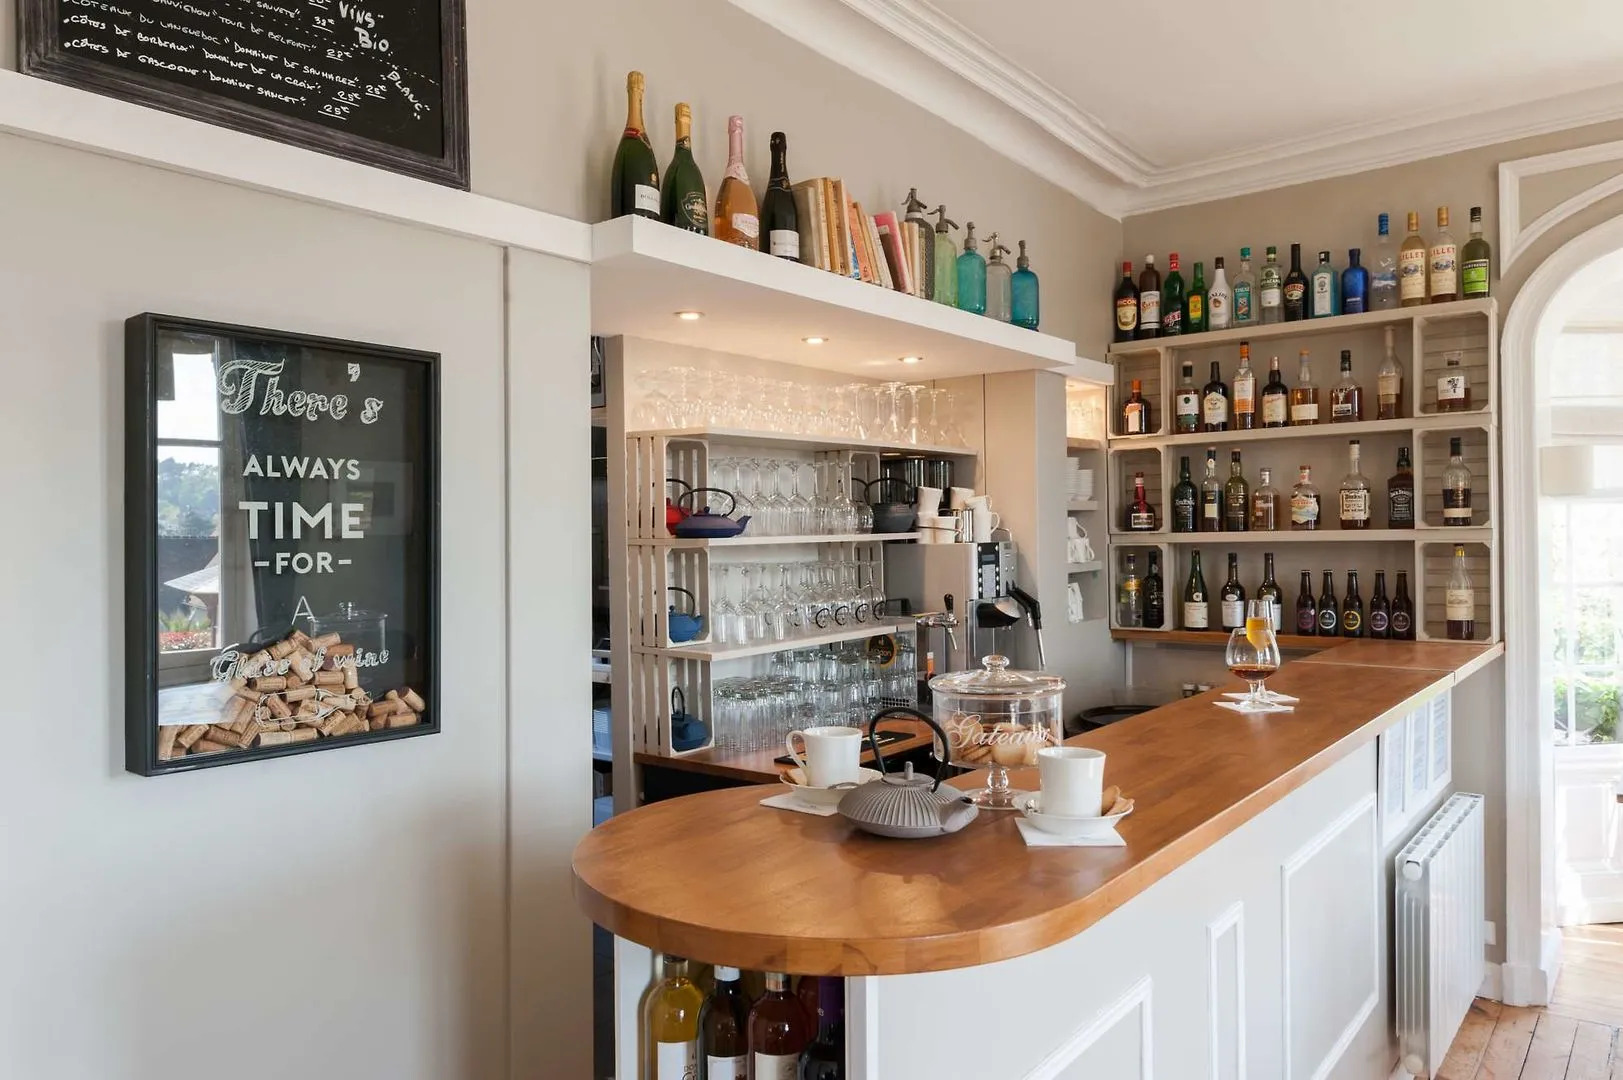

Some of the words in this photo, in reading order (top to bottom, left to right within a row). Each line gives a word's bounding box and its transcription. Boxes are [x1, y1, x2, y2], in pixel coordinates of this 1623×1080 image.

[114, 24, 131, 37] DE
[250, 63, 266, 75] DE
[116, 48, 131, 58] DE
[284, 57, 299, 69] DE
[217, 358, 383, 424] There's
[242, 455, 361, 481] ALWAYS
[238, 501, 365, 539] TIME
[291, 595, 318, 627] A
